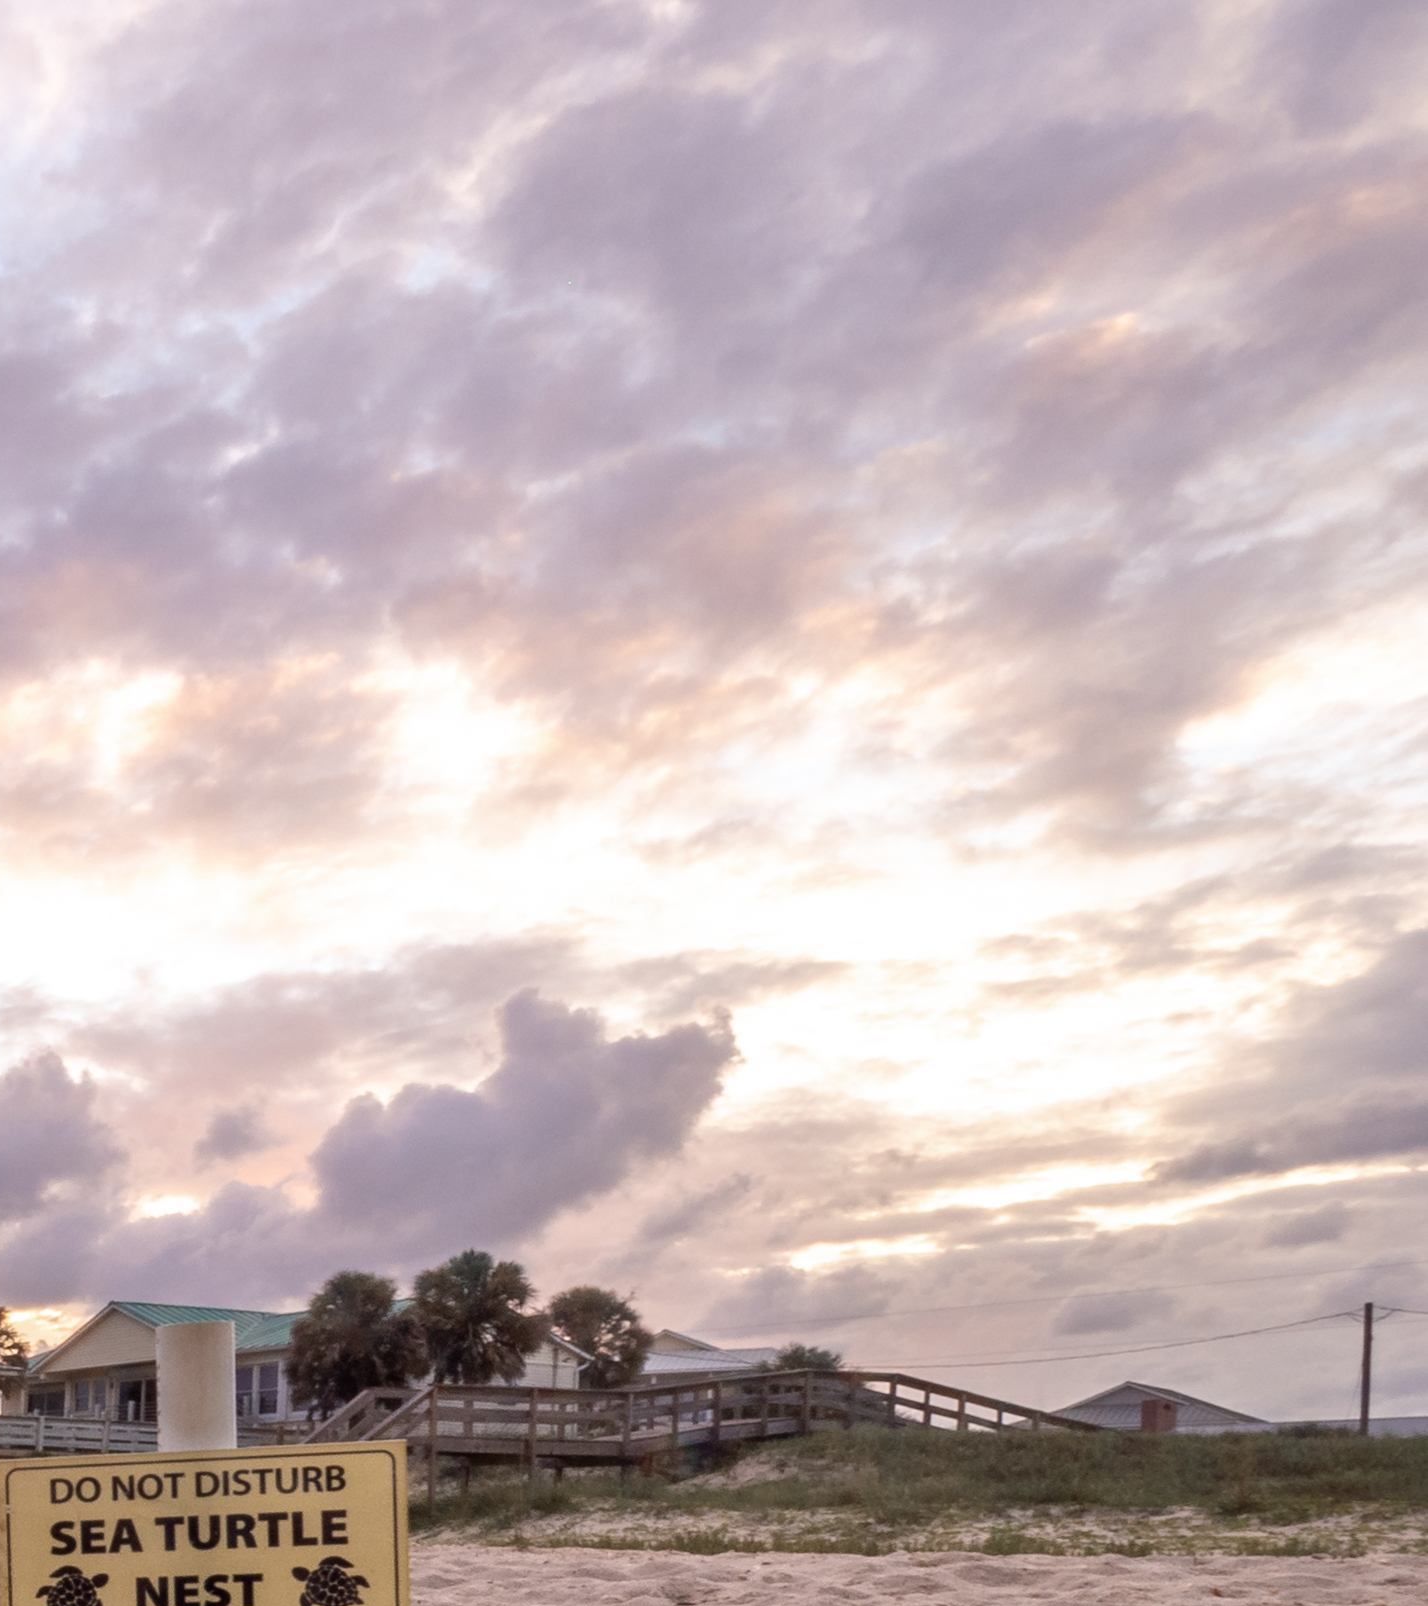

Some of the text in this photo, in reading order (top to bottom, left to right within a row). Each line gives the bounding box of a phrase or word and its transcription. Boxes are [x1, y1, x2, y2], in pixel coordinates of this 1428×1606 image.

[50, 1465, 346, 1504] DO NOT DISTURB
[51, 1510, 349, 1555] SEA TURTLE
